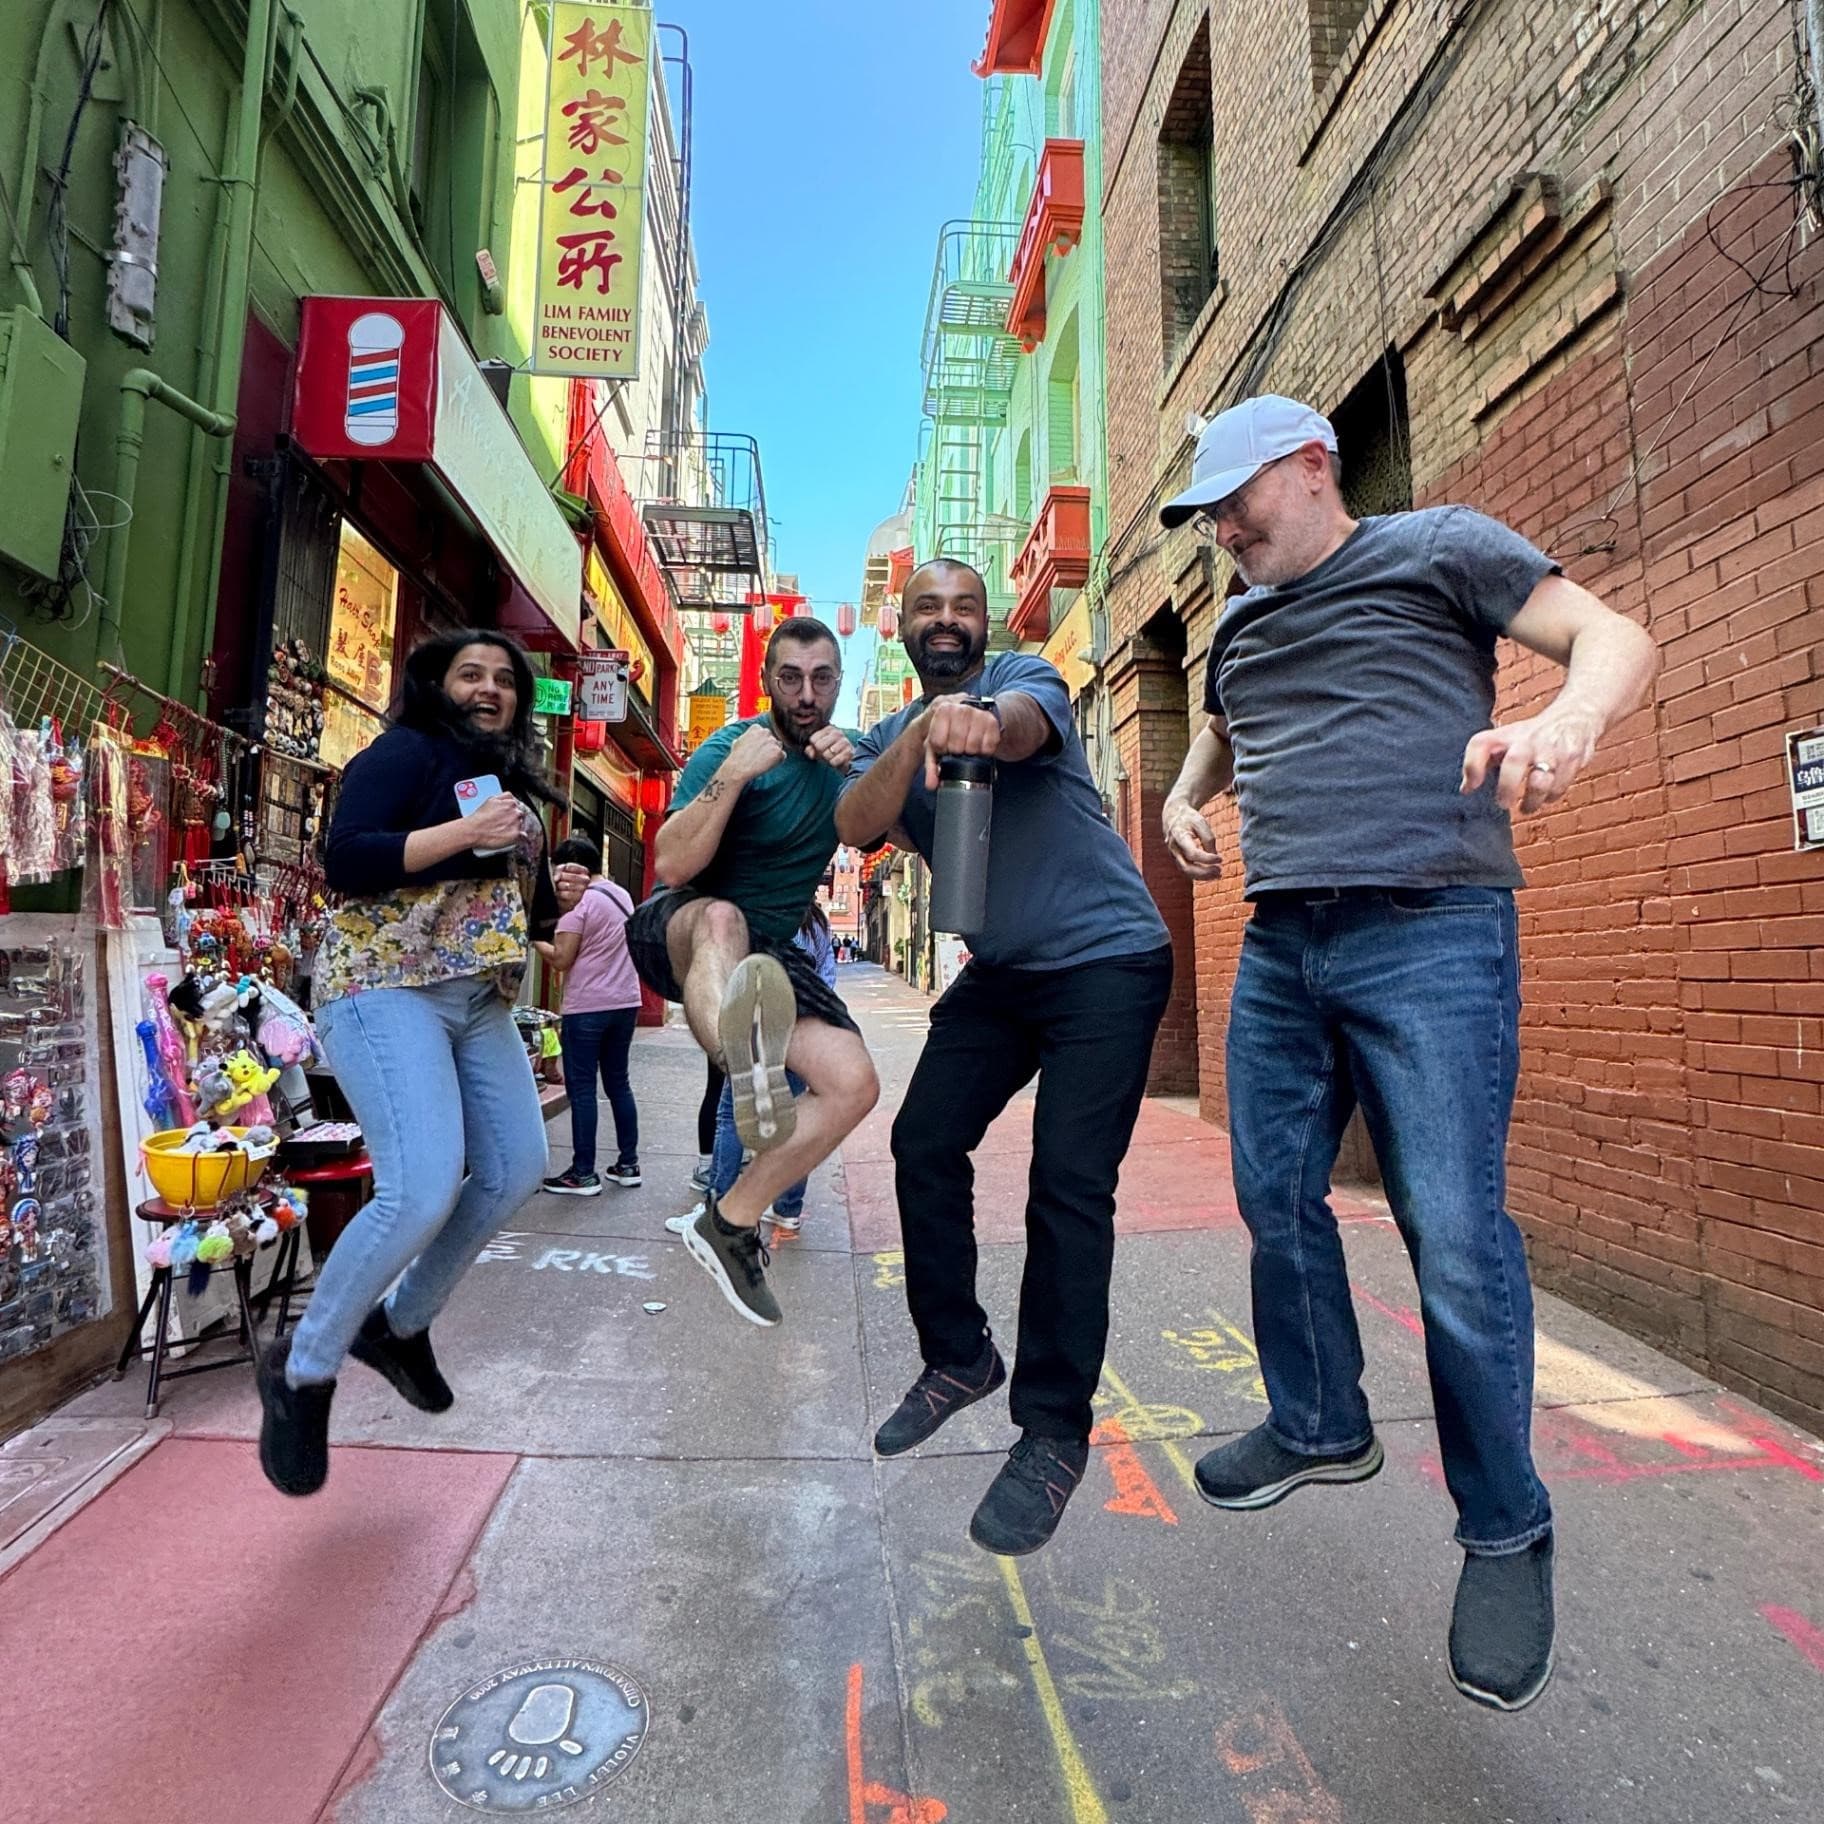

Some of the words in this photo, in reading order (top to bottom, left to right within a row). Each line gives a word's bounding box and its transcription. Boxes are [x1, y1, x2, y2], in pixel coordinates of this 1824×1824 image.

[552, 17, 645, 295] 林家公所
[544, 303, 572, 320] LIM
[578, 305, 632, 323] FAMILY
[541, 325, 633, 343] BENEVOLENT
[548, 345, 623, 362] SOCIETY
[593, 680, 614, 692] ANY
[592, 693, 615, 705] TIME
[502, 1659, 583, 1683] ALLEYWAY
[588, 1734, 640, 1785] VIOLET
[536, 1786, 577, 1808] LEE
